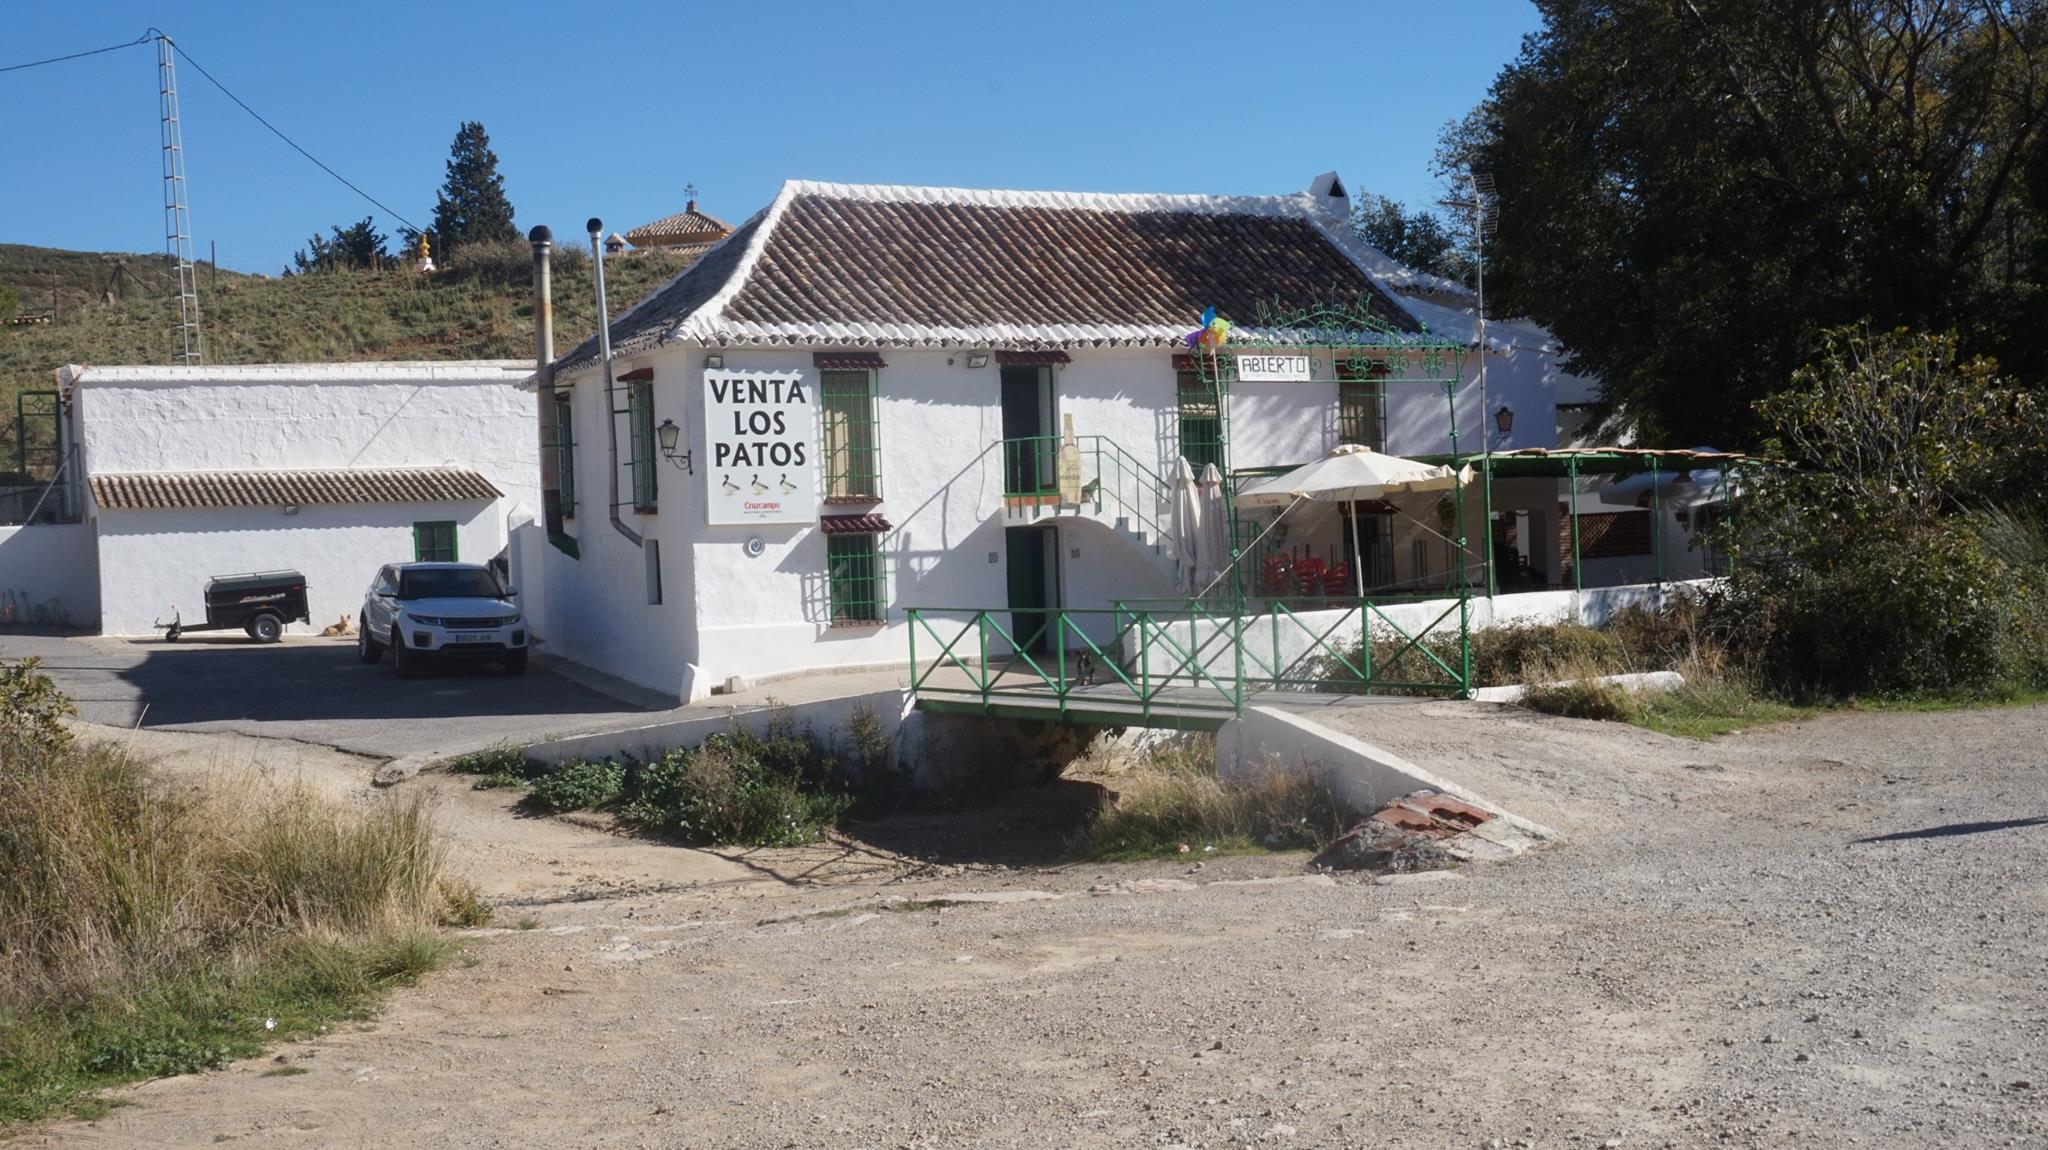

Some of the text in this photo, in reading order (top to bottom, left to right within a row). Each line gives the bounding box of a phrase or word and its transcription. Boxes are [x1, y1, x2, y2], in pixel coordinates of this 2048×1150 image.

[1241, 357, 1306, 373] ABIERTO
[709, 379, 807, 404] VENTA
[734, 410, 786, 435] LOS
[715, 441, 806, 467] PATOS
[744, 501, 780, 510] Cruzcampo
